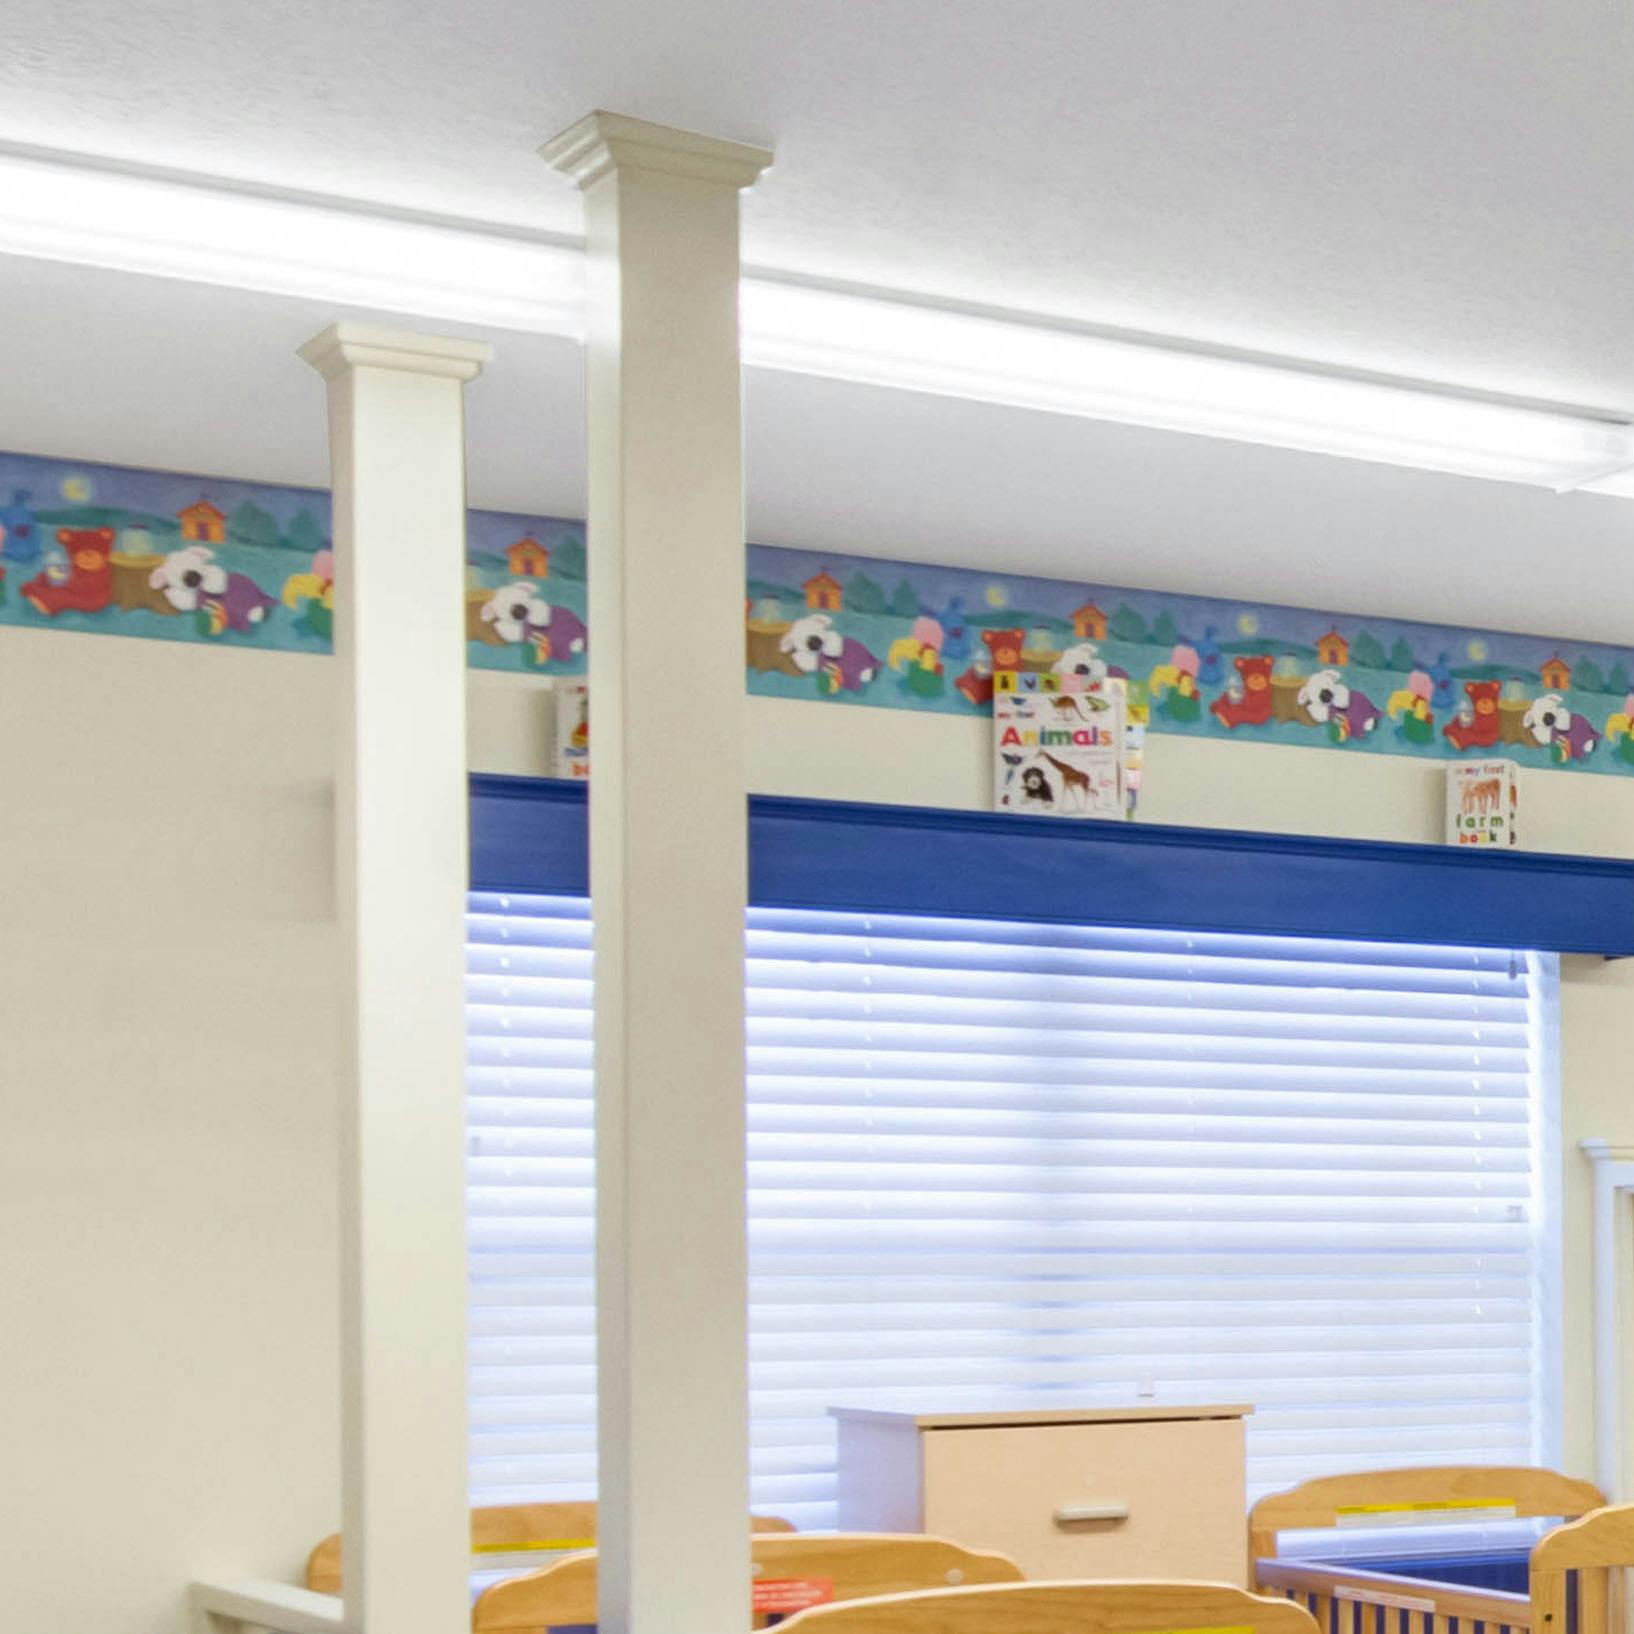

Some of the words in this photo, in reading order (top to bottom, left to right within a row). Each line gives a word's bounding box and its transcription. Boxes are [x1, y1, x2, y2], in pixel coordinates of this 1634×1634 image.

[1001, 725, 1113, 746] Animals
[1456, 813, 1504, 829] farm
[1459, 830, 1498, 844] book
